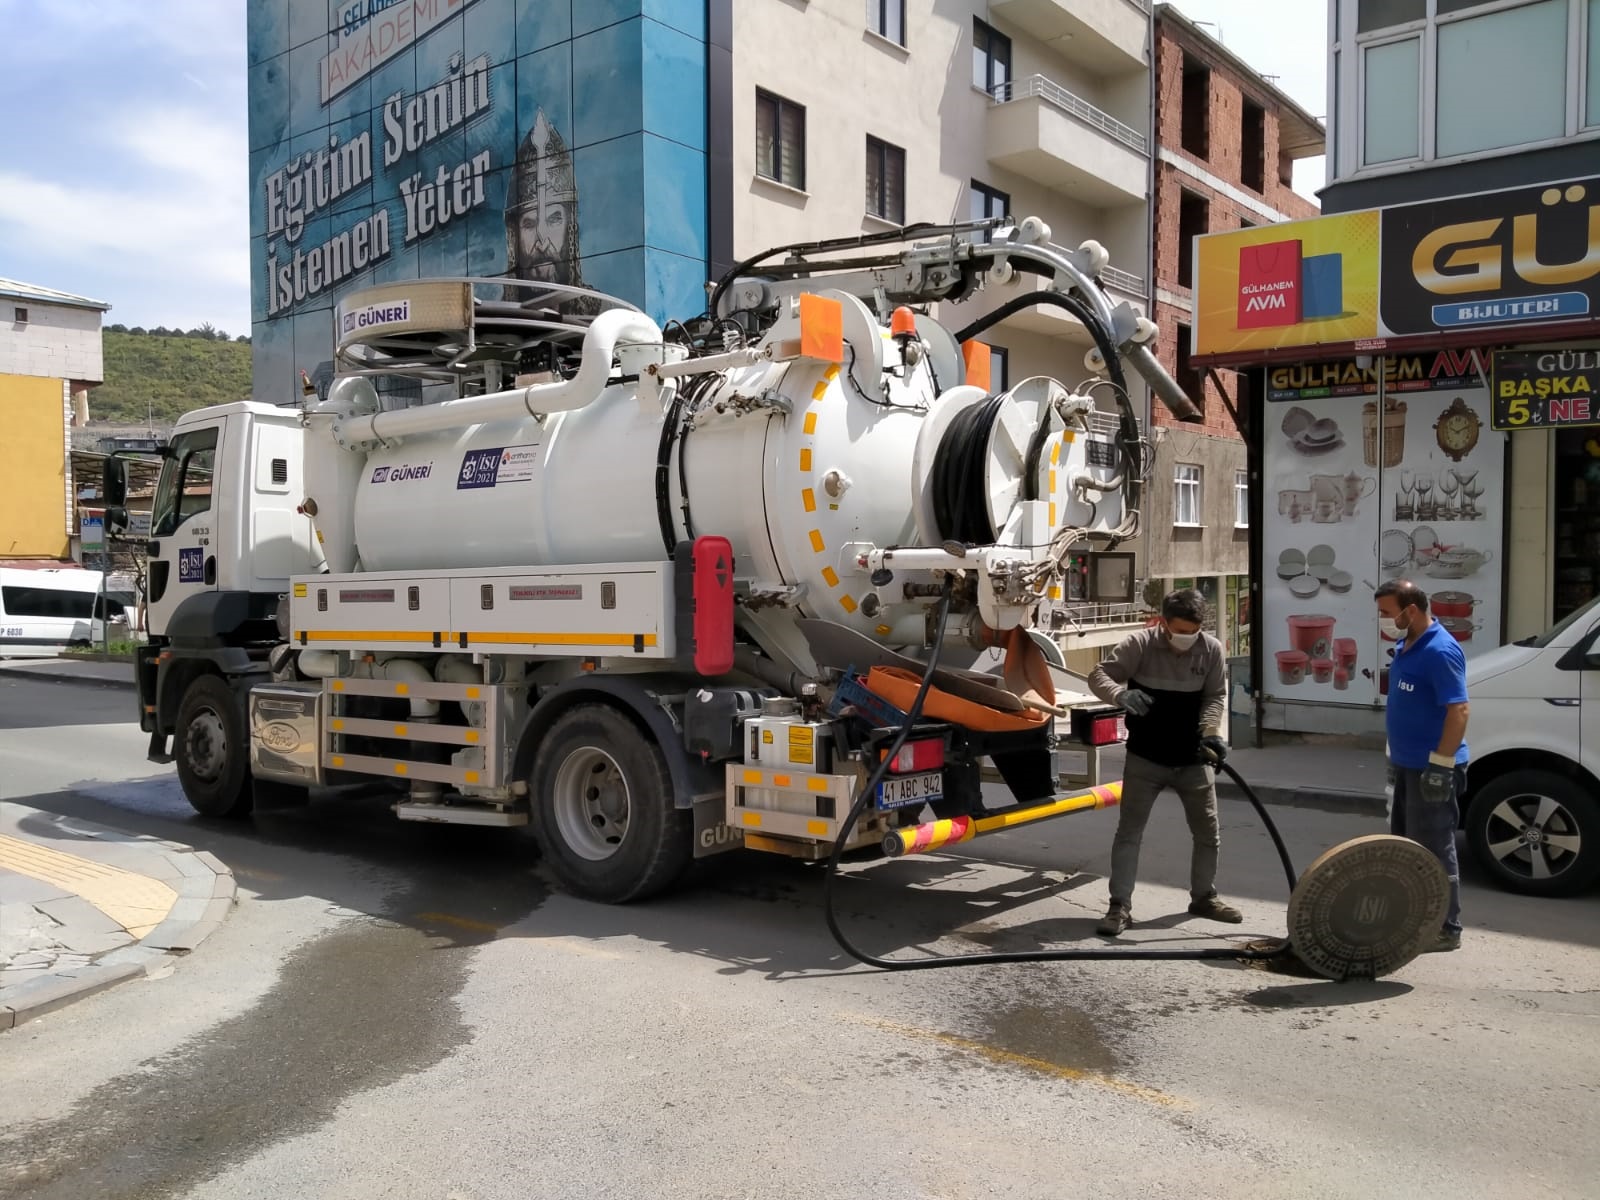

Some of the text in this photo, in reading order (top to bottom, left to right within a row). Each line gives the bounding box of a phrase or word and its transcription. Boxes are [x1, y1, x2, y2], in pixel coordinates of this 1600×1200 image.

[343, 0, 399, 37] SELAH
[265, 53, 491, 242] Eğitim Senin
[267, 149, 491, 317] İstemen Yeter
[1411, 184, 1600, 295] GÜ
[1241, 280, 1295, 295] GÜLHANEM
[358, 301, 408, 328] GÜNERİ
[1246, 293, 1286, 312] AVM
[1500, 375, 1591, 399] BAŞKA
[1549, 397, 1591, 422] NE
[390, 461, 434, 482] GÜNERİ
[479, 453, 500, 470] İSU
[476, 472, 495, 484] 2021
[884, 782, 896, 802] 41
[900, 778, 918, 800] ABC
[923, 774, 940, 795] 942
